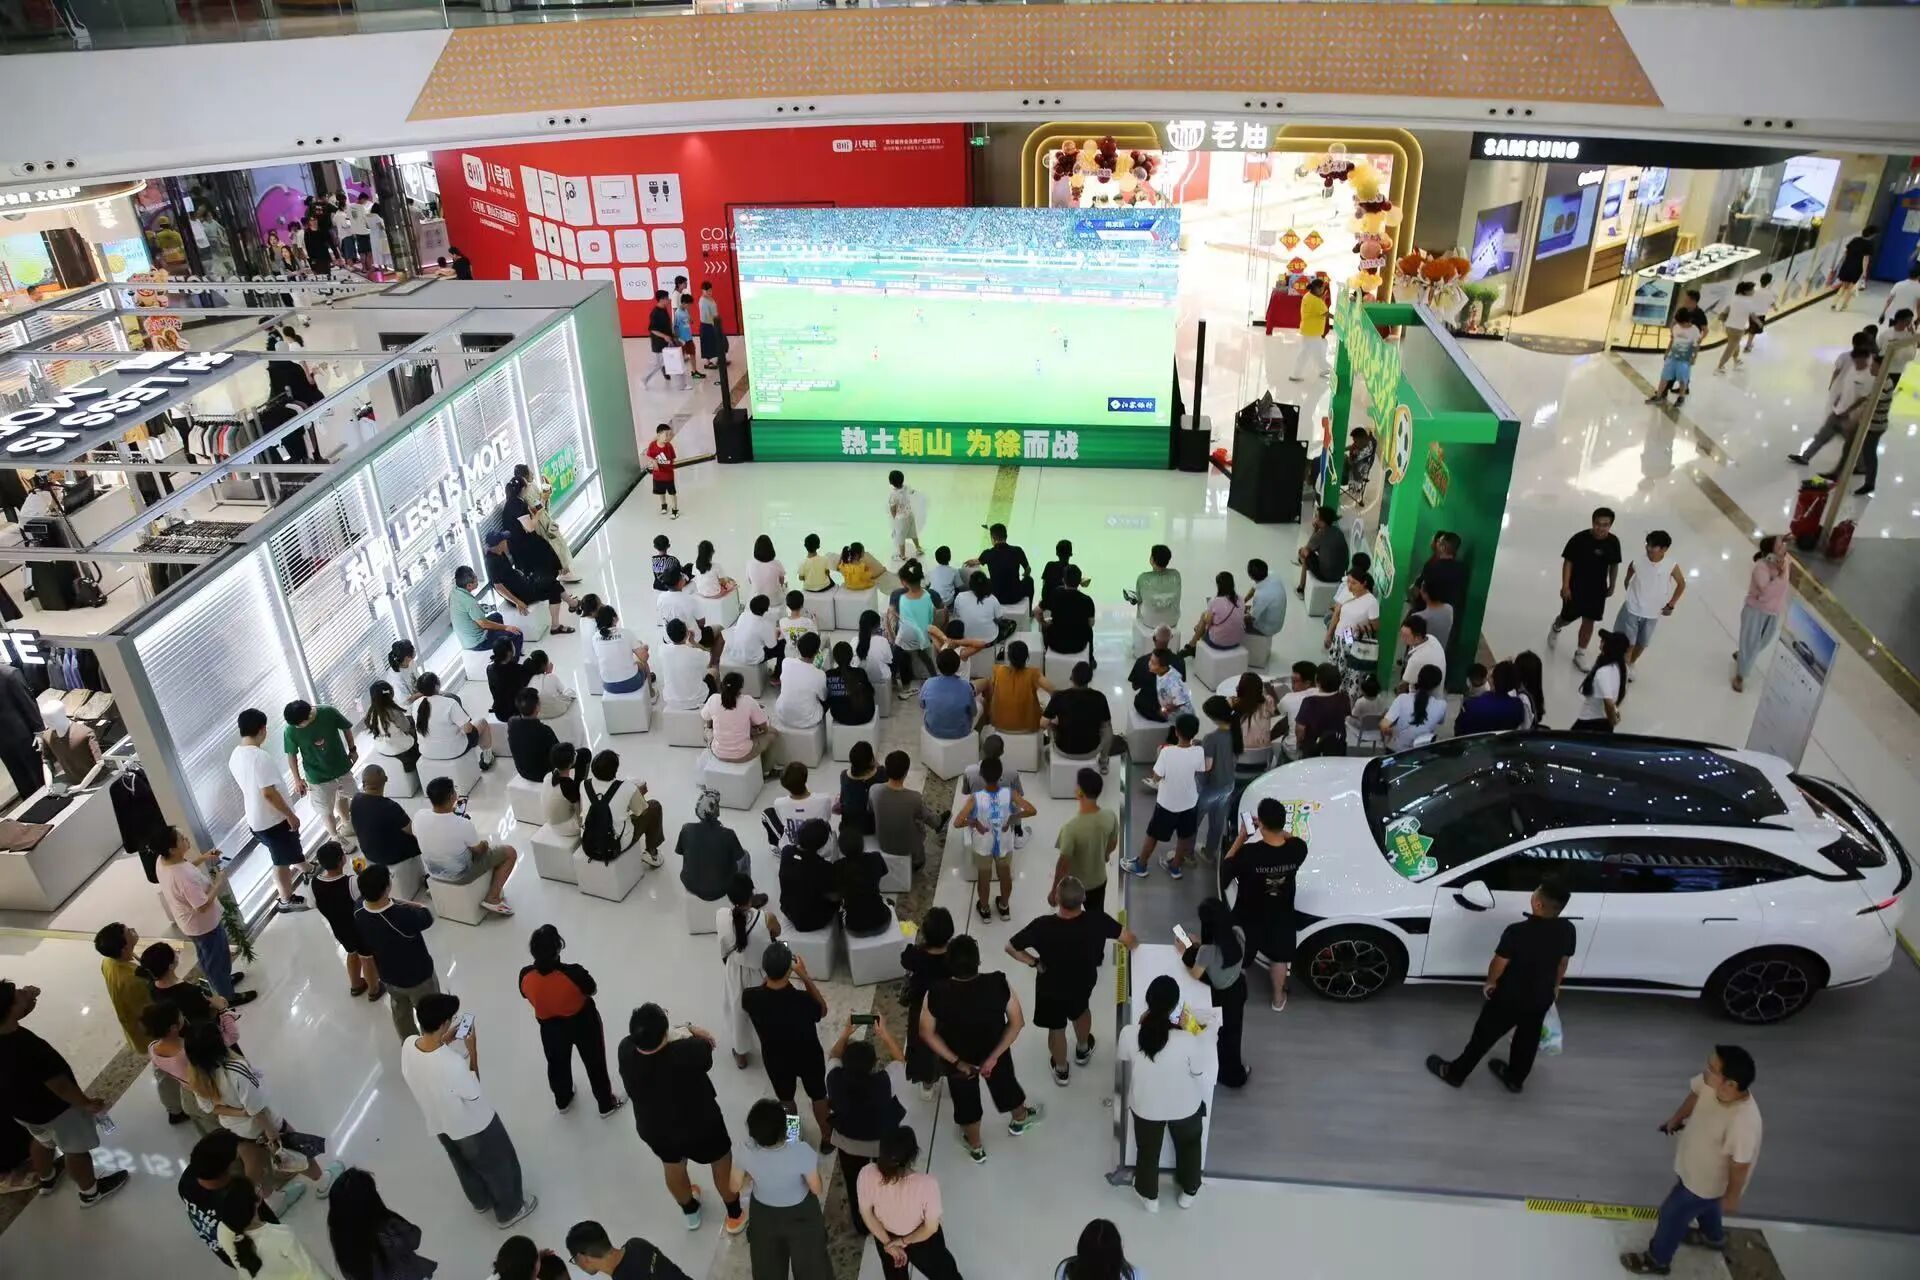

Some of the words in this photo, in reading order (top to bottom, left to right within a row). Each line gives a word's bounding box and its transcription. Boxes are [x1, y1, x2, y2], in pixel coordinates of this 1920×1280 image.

[1484, 138, 1580, 159] SAMSUNG
[485, 161, 515, 190] 八号机
[59, 377, 189, 428] LESS
[841, 427, 952, 457] 热土铜山
[966, 429, 1080, 460] 为徐而战
